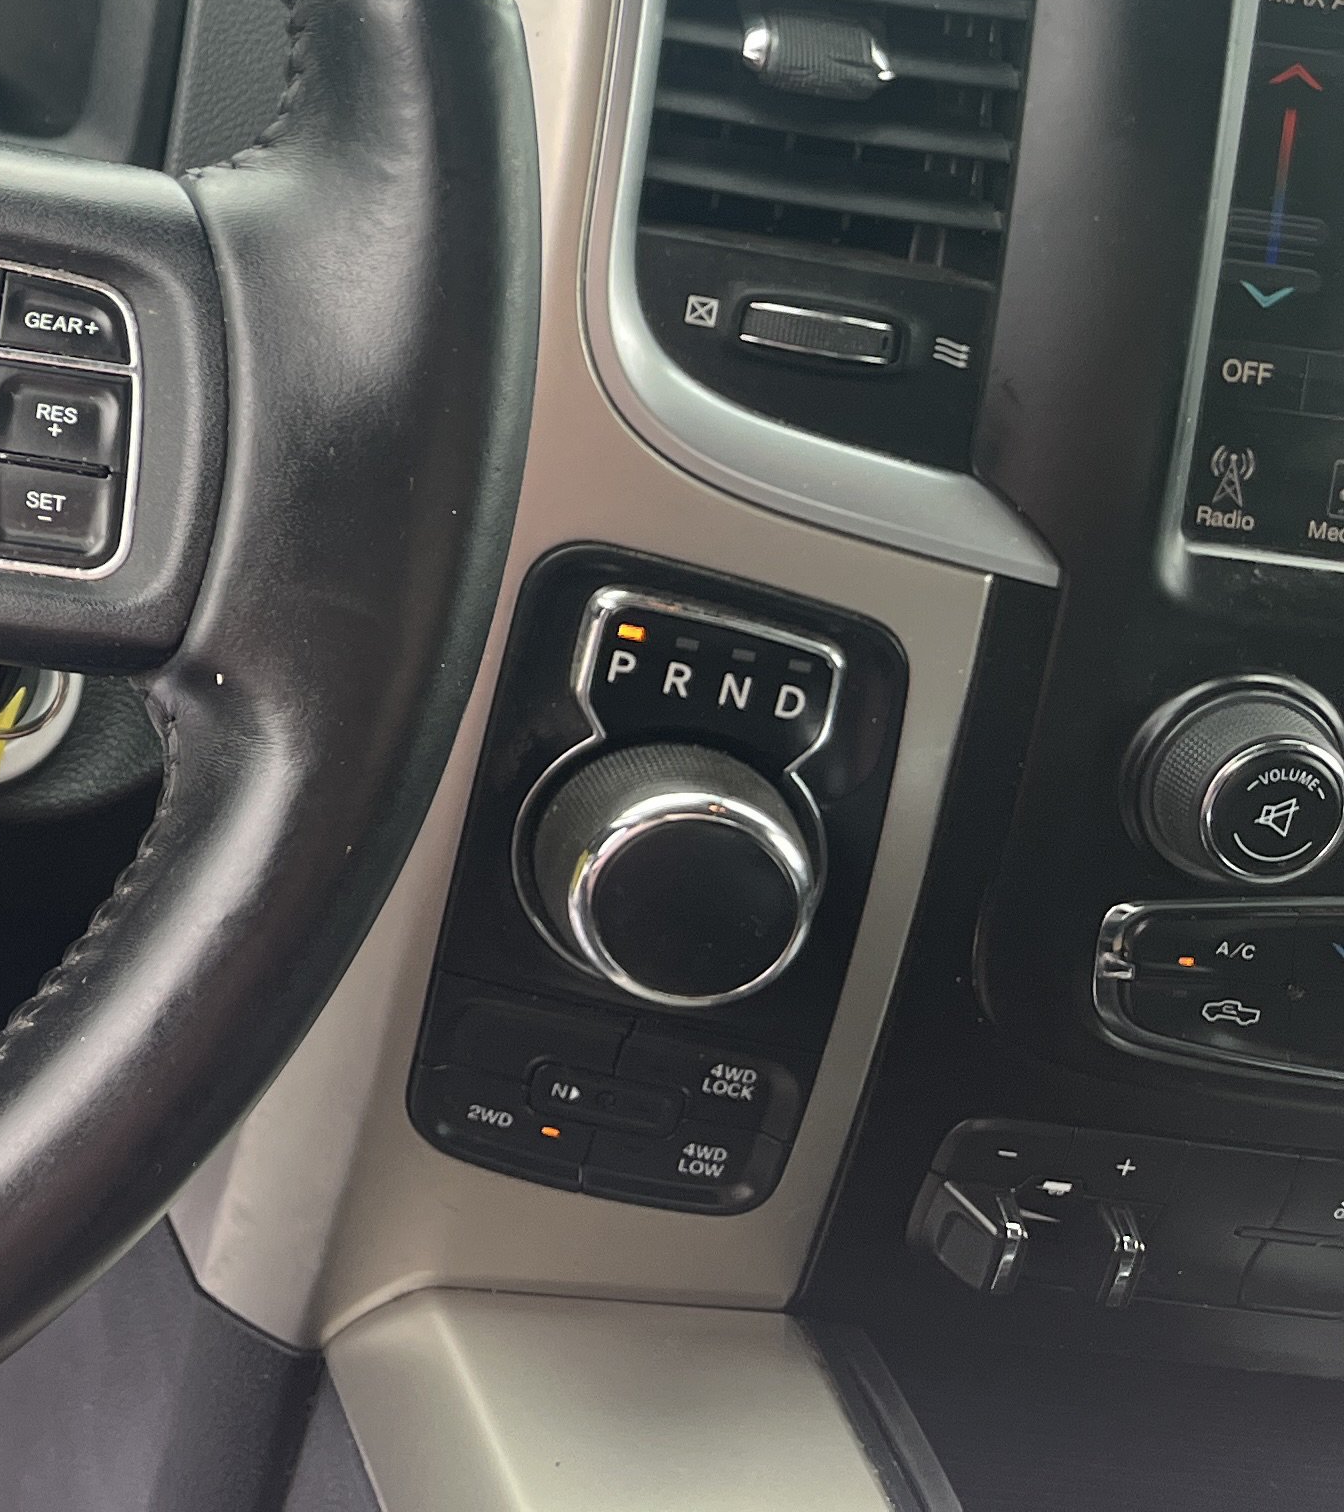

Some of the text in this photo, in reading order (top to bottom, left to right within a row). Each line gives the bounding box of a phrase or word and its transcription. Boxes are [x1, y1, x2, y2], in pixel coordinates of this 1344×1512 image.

[1221, 358, 1274, 385] OFF
[35, 403, 78, 425] RES
[25, 490, 67, 512] SET
[1196, 505, 1255, 532] Radio
[607, 650, 806, 719] P R N D
[1258, 768, 1321, 792] VOLUME
[1216, 941, 1256, 960] A/C
[709, 1063, 757, 1084] 4WD
[702, 1078, 755, 1102] LOCK
[467, 1104, 513, 1128] 2WD
[682, 1142, 728, 1163] 4WD
[678, 1158, 726, 1179] LOW
